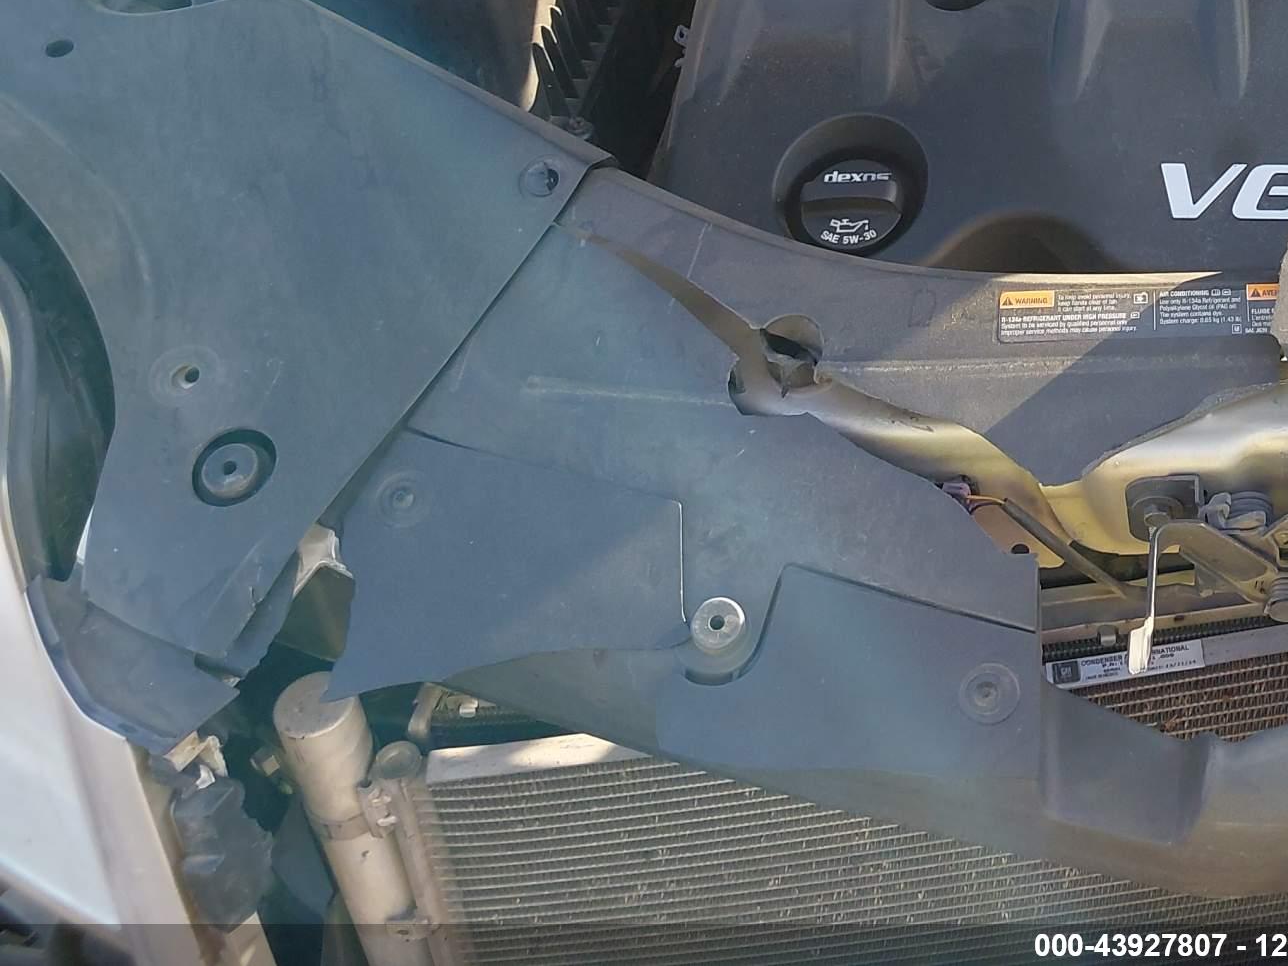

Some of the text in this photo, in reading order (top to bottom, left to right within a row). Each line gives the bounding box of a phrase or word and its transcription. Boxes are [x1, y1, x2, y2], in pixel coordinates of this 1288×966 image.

[820, 229, 878, 244] SAE 5W-30
[1015, 297, 1049, 305] WARNING
[1080, 656, 1123, 667] CONDENSER
